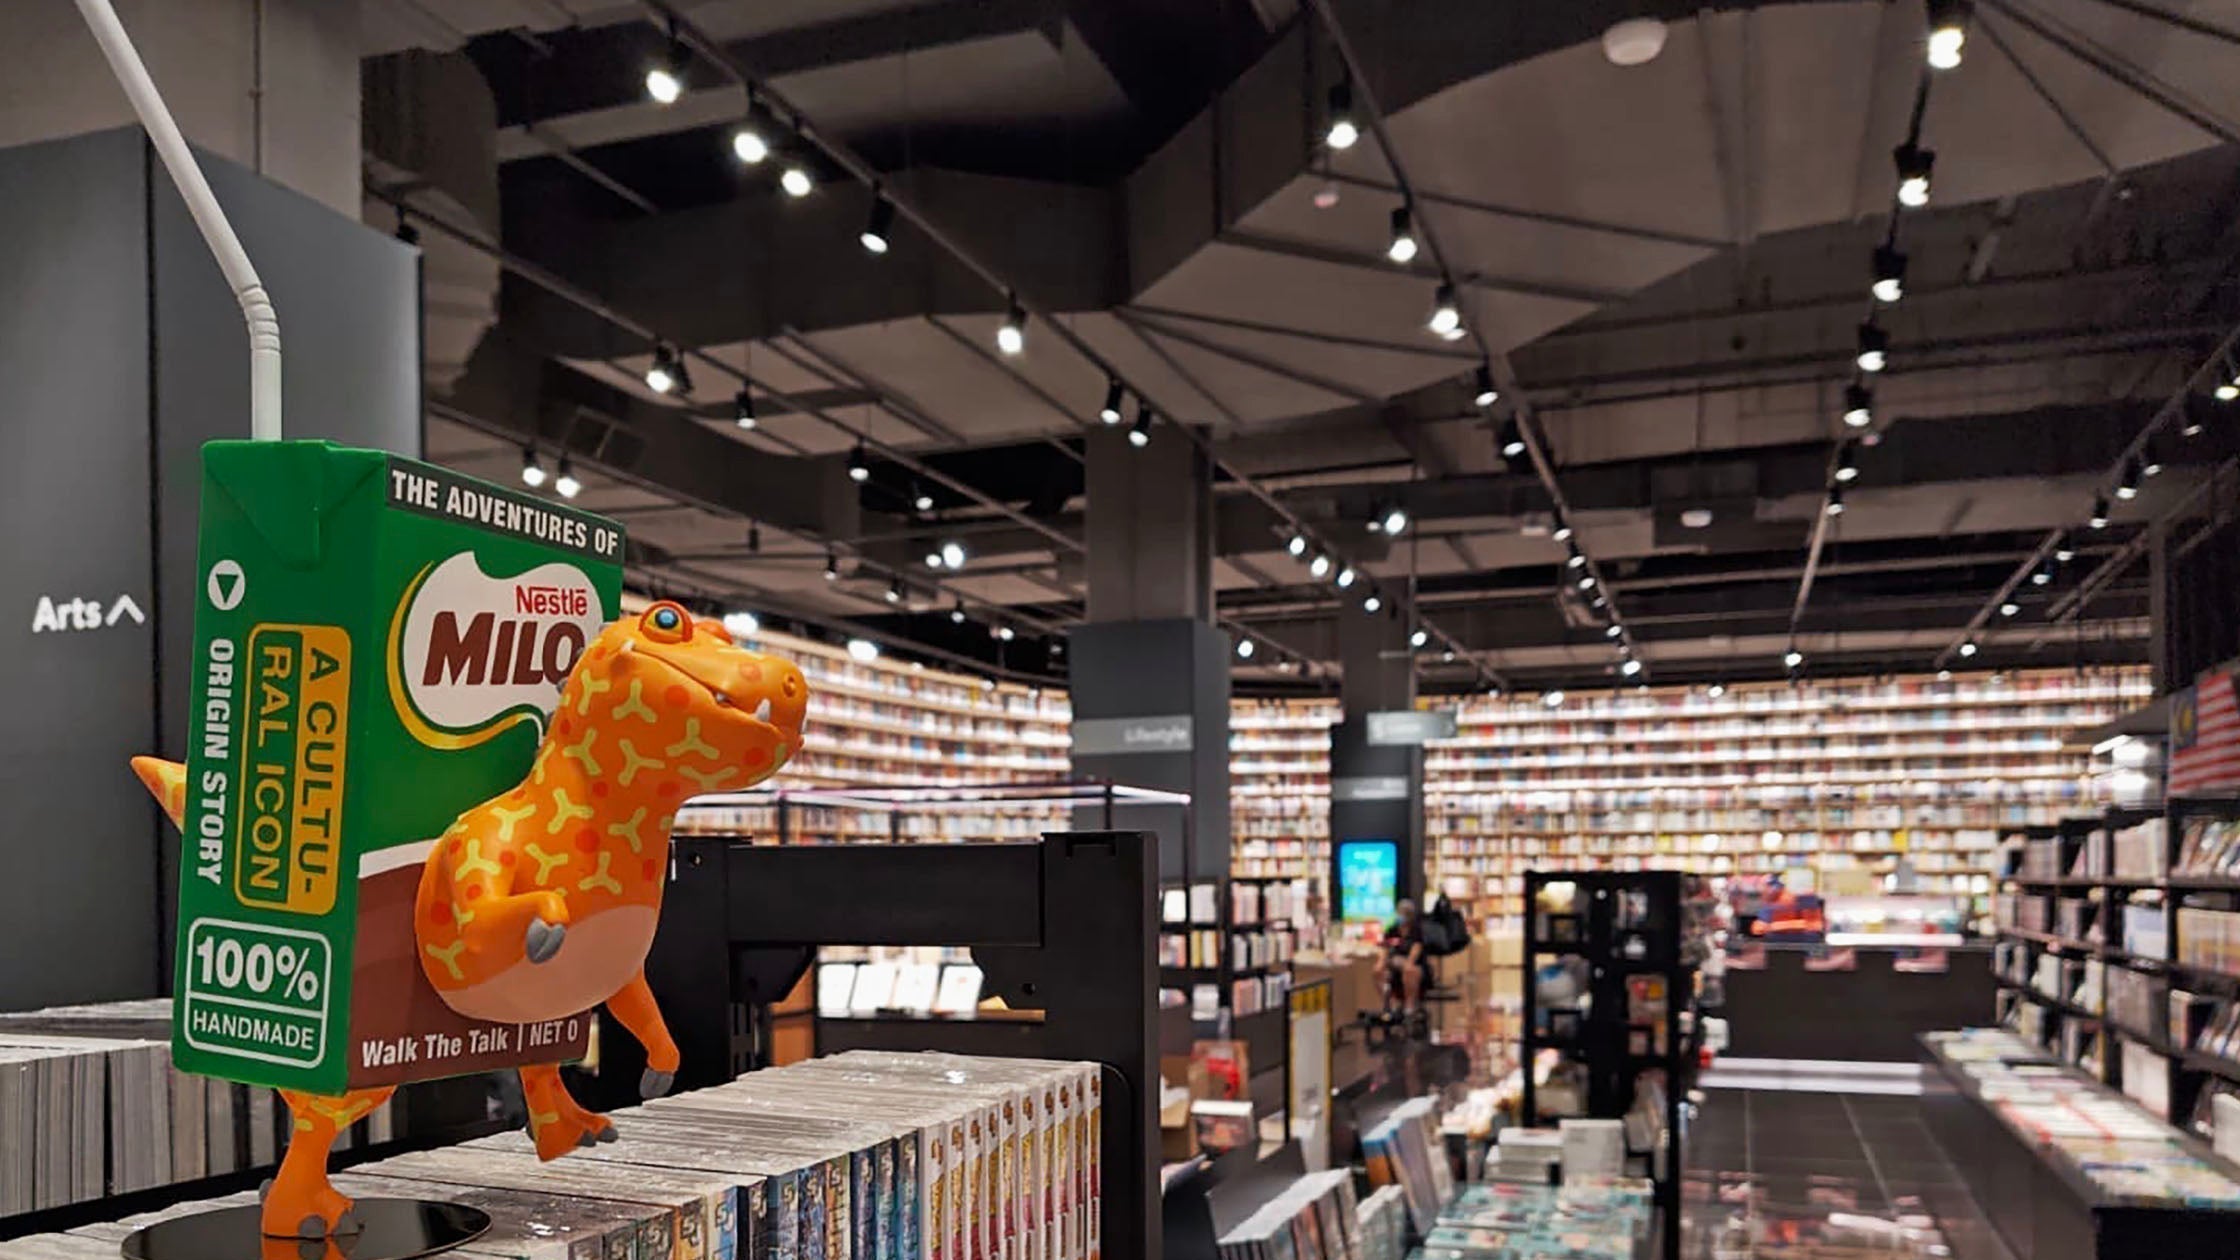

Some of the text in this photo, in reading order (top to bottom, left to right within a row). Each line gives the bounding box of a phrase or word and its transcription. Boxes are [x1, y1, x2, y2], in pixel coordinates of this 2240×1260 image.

[391, 469, 619, 556] THE ADVENTURES OF
[32, 596, 102, 633] Arts
[422, 610, 586, 686] MILO
[197, 637, 235, 885] ORIGIN STORY
[249, 646, 293, 890] RAL ICON
[297, 647, 341, 893] A CULTU-
[196, 935, 319, 1001] 100%
[192, 1009, 315, 1051] HANDMADE
[362, 1039, 417, 1068] Walk
[424, 1033, 462, 1060] The
[469, 1027, 508, 1054] Talk
[529, 1022, 561, 1047] NET
